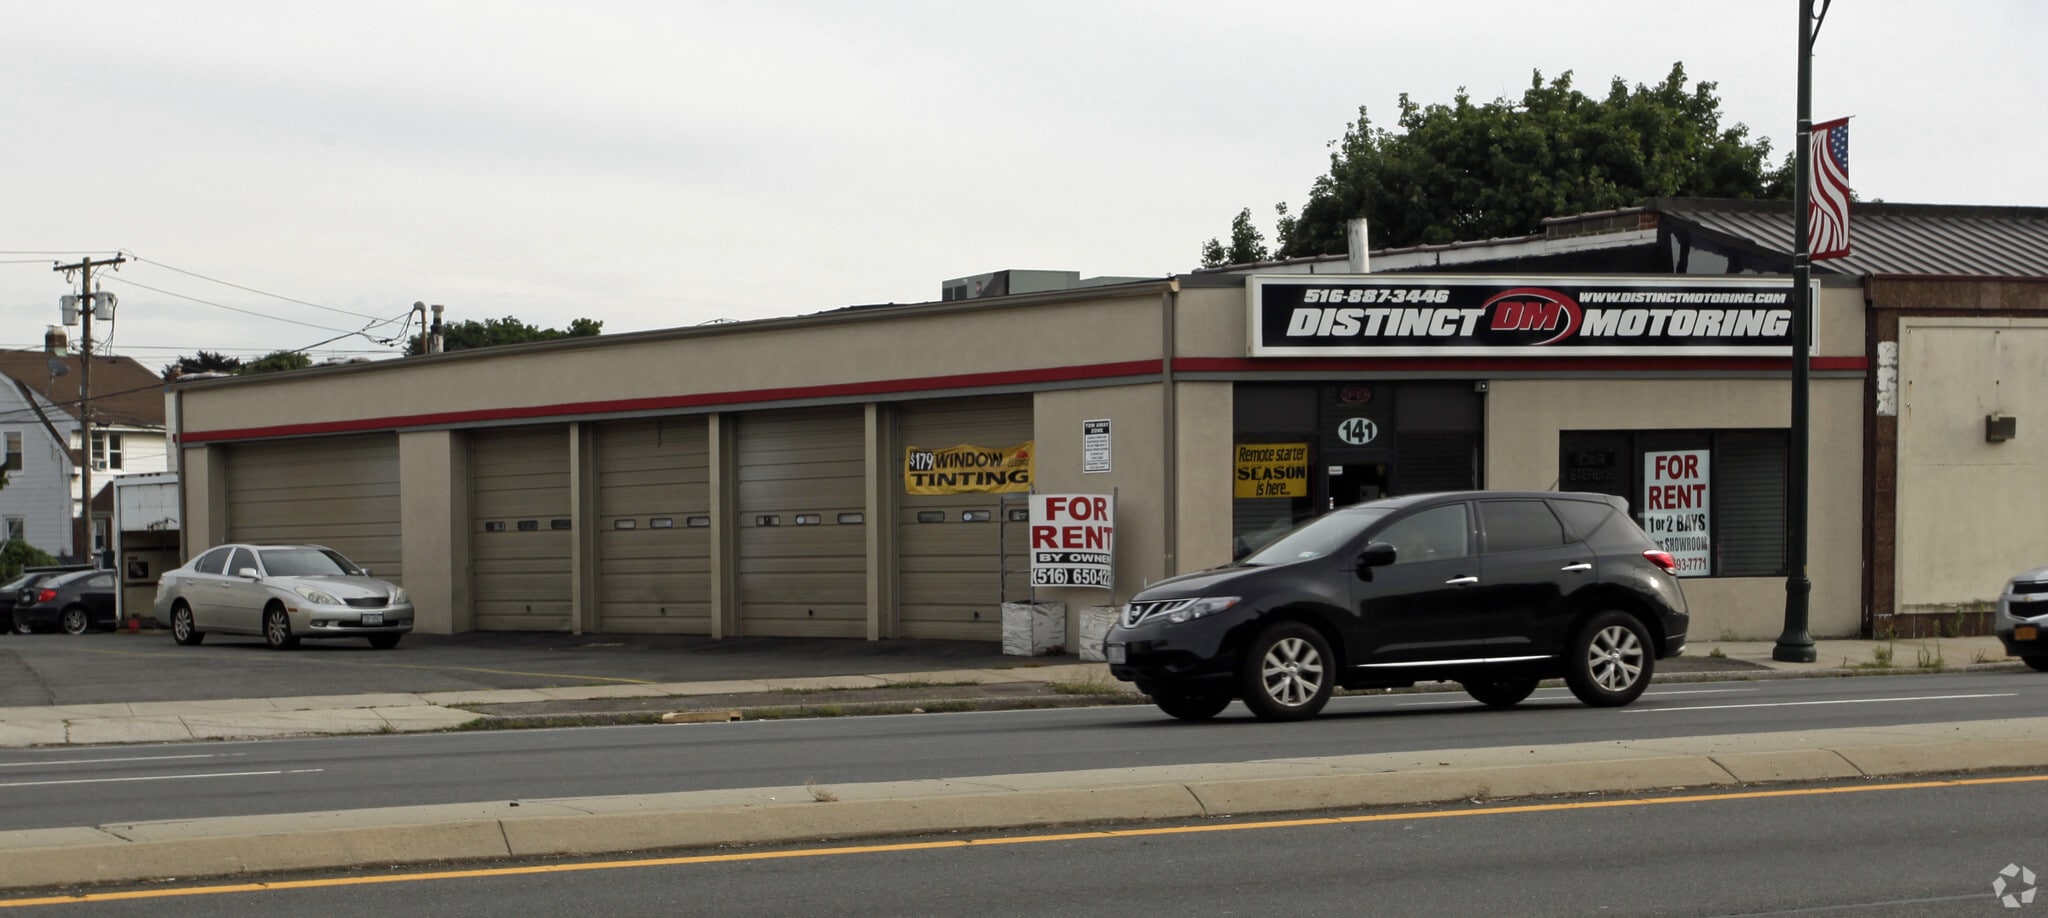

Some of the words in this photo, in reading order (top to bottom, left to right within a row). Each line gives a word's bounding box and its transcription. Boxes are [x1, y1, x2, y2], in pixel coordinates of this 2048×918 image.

[1303, 289, 1450, 303] 516-887-3446
[1579, 292, 1786, 304] WWW.DISTINCTMOTORING.COM
[1286, 308, 1486, 336] DISTINCT
[1490, 302, 1562, 331] DM
[1579, 309, 1792, 336] MOTORING
[1342, 419, 1374, 442] 141
[909, 452, 934, 470] $179
[935, 452, 1003, 468] WINDOW
[1239, 447, 1274, 462] Remote
[1275, 447, 1306, 461] starter
[1238, 466, 1305, 480] SEASON
[1655, 454, 1699, 480] FOR
[910, 470, 1029, 486] TINTING
[1256, 481, 1264, 496] is
[1648, 484, 1706, 510] RENT
[1046, 496, 1108, 521] FOR
[1649, 516, 1654, 533] 1
[1655, 519, 1665, 531] or
[1666, 516, 1673, 532] 2
[1676, 513, 1706, 532] BAYS
[1032, 525, 1113, 551] RENT
[1665, 537, 1708, 552] SHOWROOM
[1039, 553, 1063, 562] BY
[1069, 553, 1112, 563] OWNE
[1674, 557, 1707, 572] 93-7771
[1033, 568, 1069, 585] (516)
